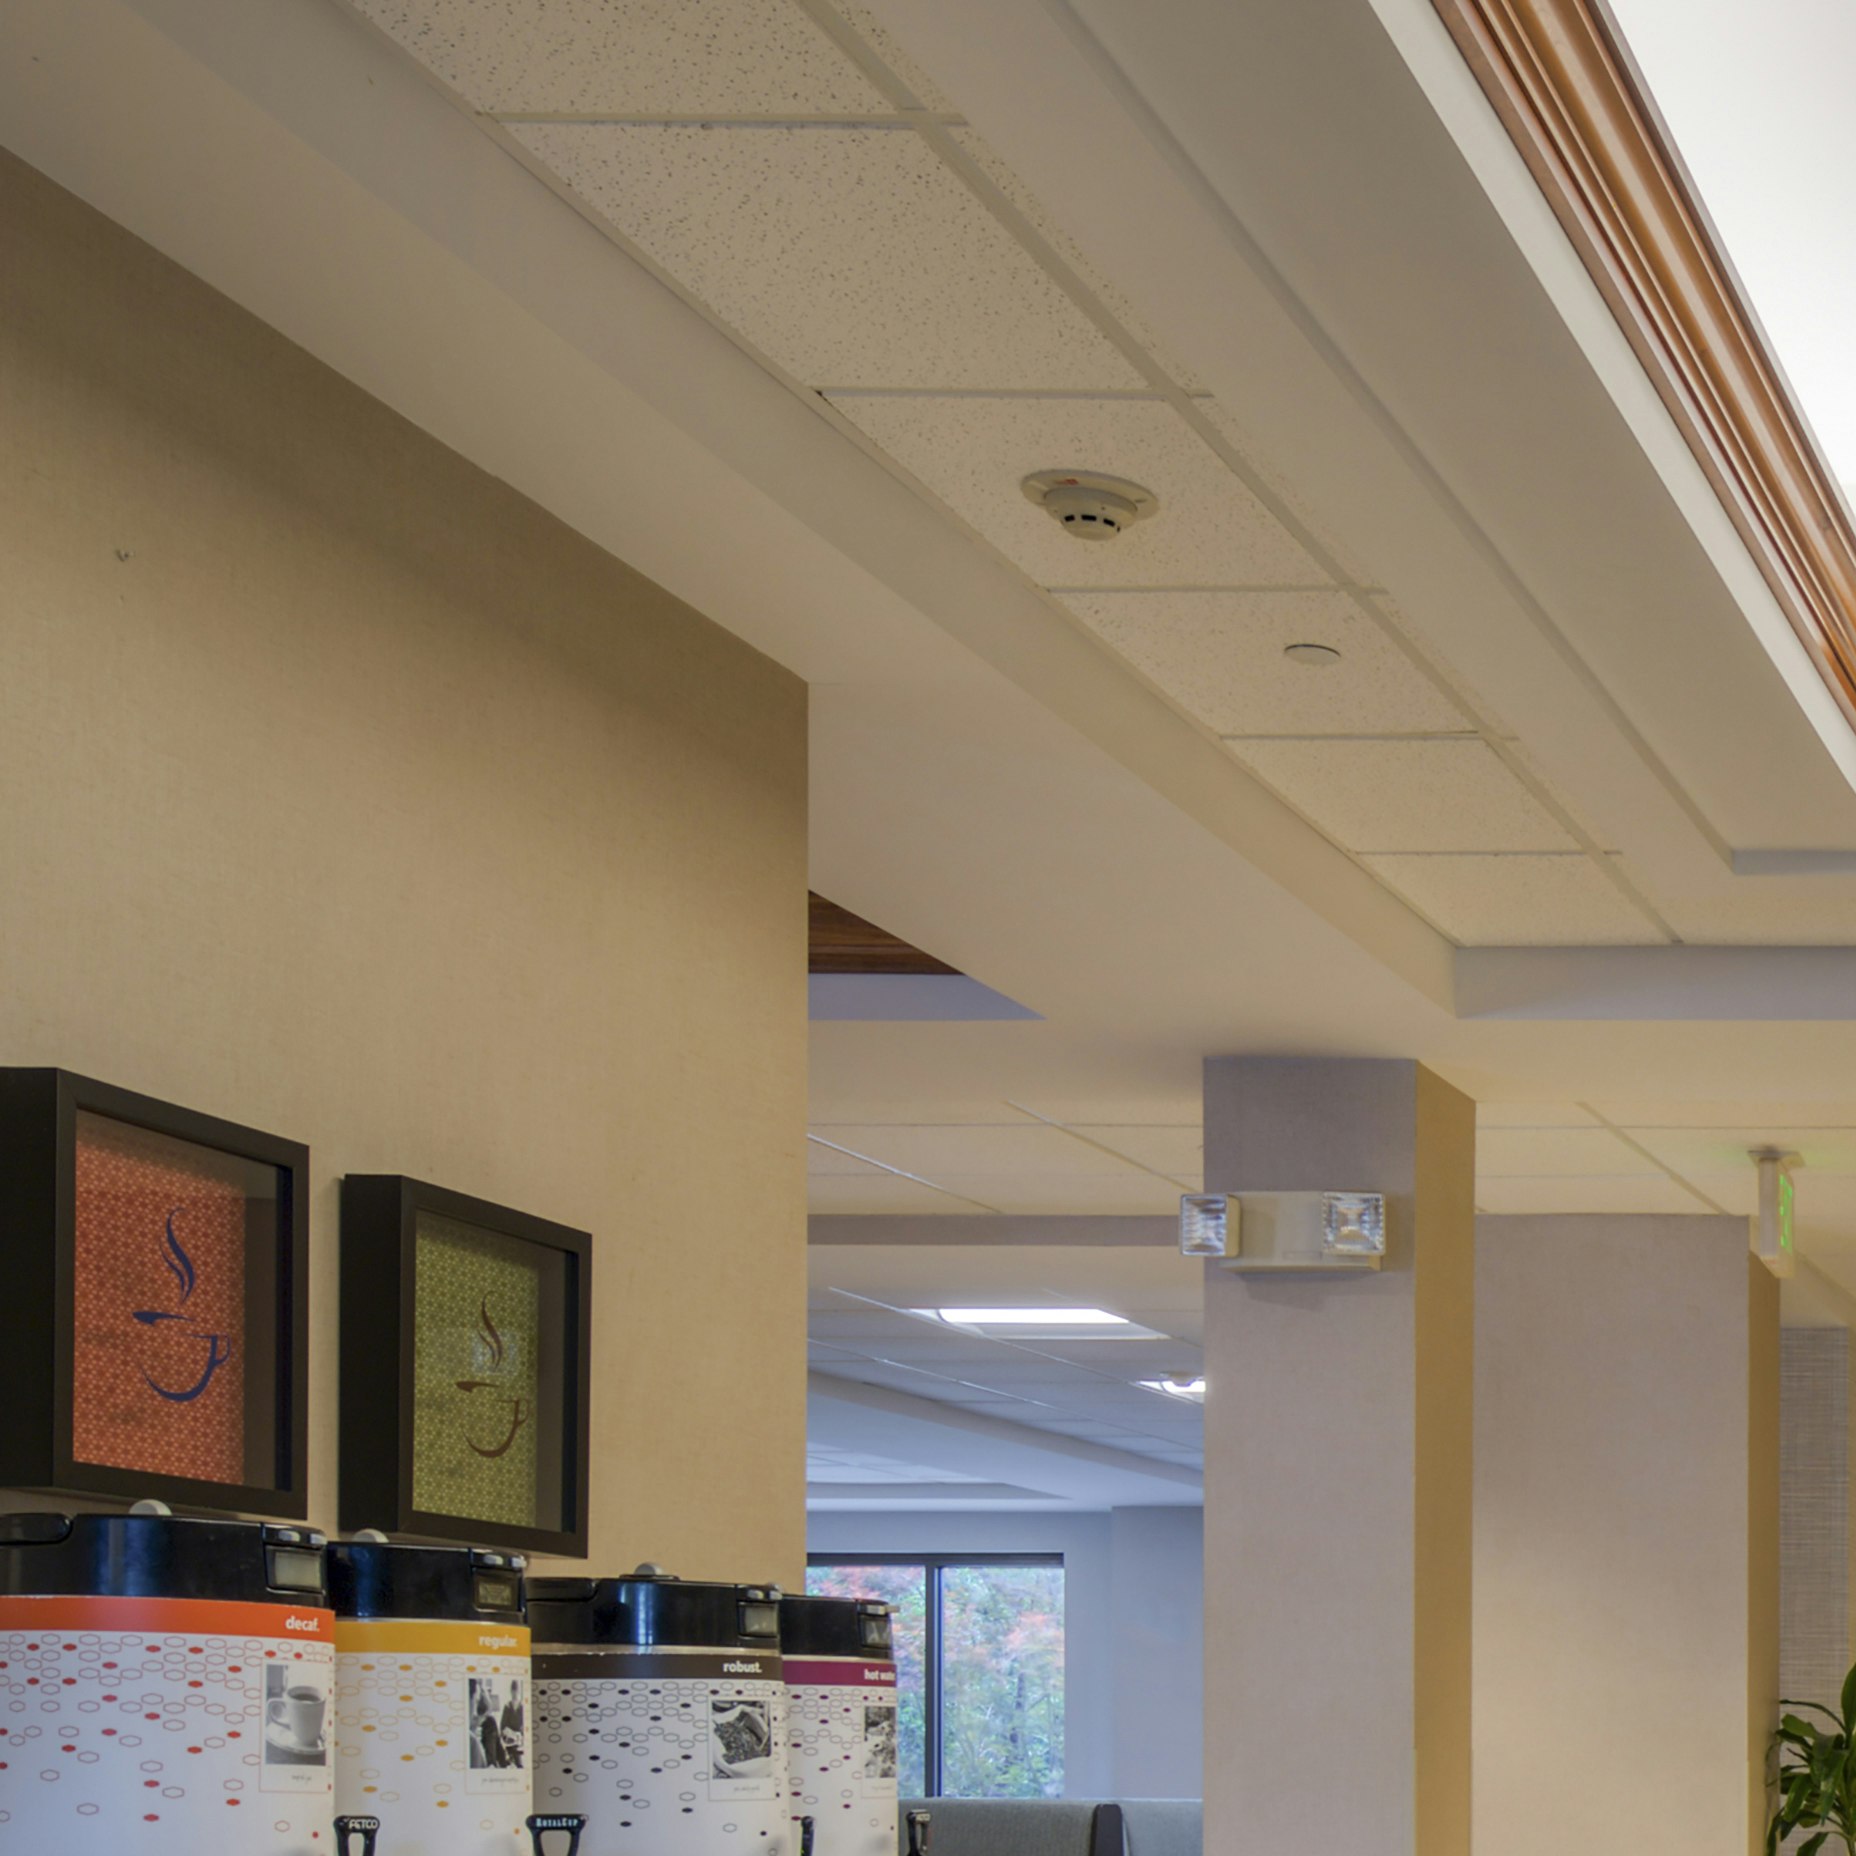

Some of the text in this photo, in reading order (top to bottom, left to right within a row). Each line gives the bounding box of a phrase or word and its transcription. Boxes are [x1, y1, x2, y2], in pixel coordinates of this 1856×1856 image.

[285, 1616, 320, 1632] decaf.
[723, 1661, 763, 1673] robust.
[864, 1669, 879, 1681] hot
